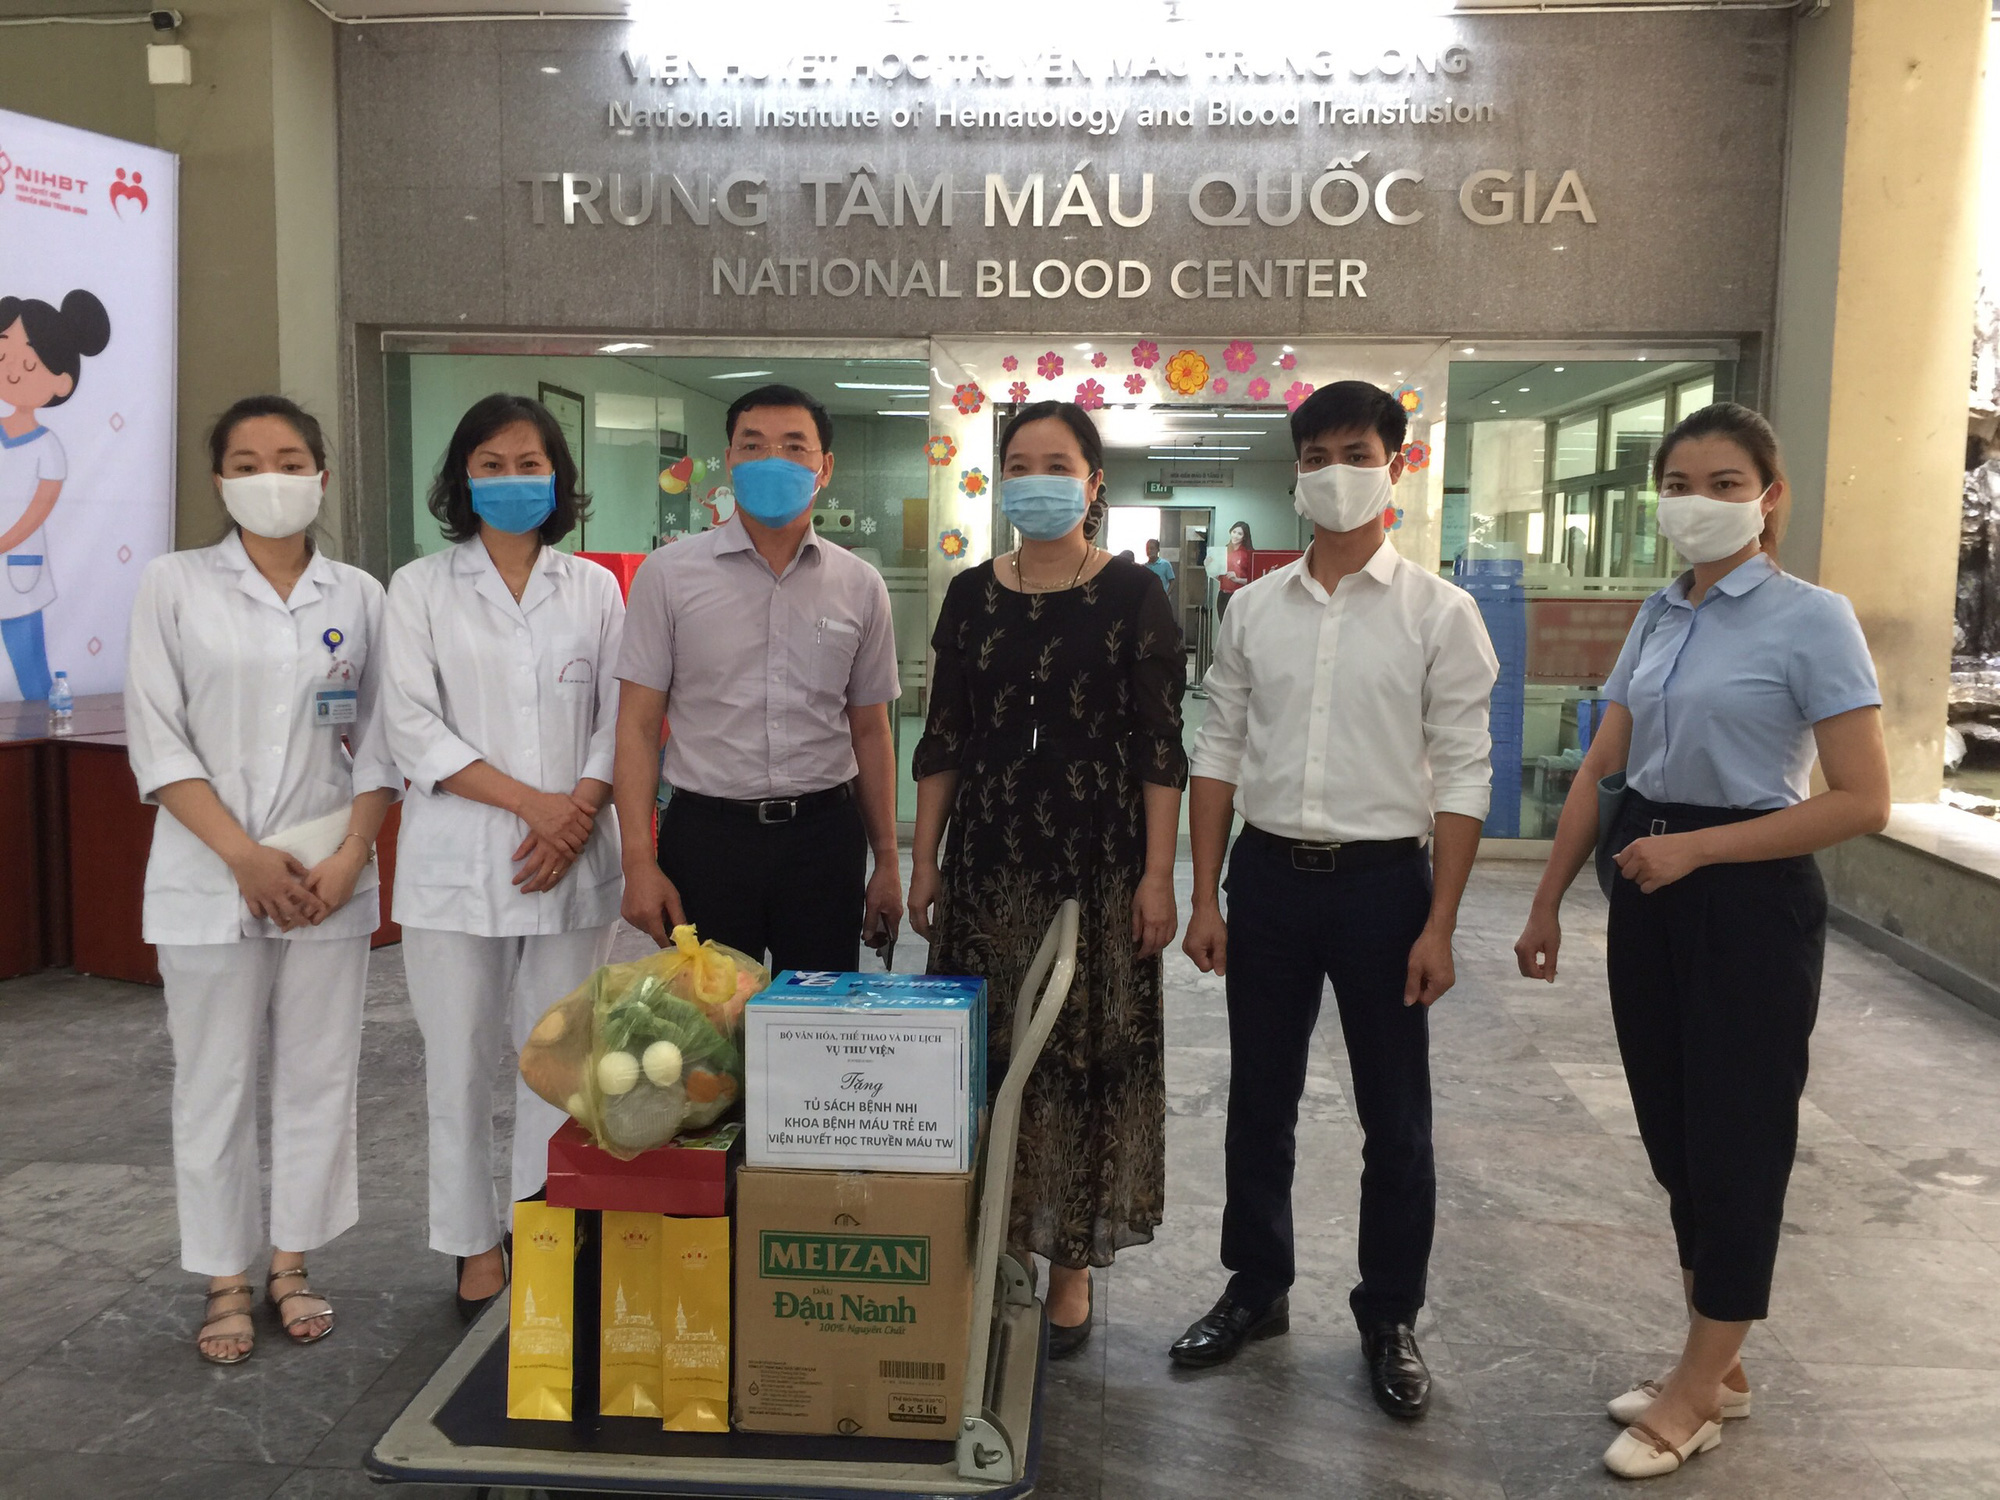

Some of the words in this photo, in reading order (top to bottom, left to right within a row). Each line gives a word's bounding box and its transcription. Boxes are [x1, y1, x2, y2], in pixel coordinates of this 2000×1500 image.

[608, 101, 741, 127] National
[754, 101, 879, 127] Institute
[891, 101, 922, 127] of
[935, 101, 1125, 135] Hematology
[1137, 101, 1194, 127] and
[1207, 101, 1299, 126] Blood
[1312, 97, 1494, 126] Transfusion
[15, 165, 88, 194] NIHBT
[516, 170, 768, 227] TRUNG
[800, 161, 953, 228] TÂM
[984, 160, 1153, 228] MÁU
[1188, 151, 1425, 227] QUỐC
[1459, 169, 1598, 225] GIA
[711, 257, 962, 298] NATIONAL
[975, 259, 1152, 299] BLOOD
[1170, 258, 1368, 299] CENTER
[780, 1030, 793, 1041] BỘ
[795, 1031, 813, 1040] VĂN
[816, 1031, 838, 1041] HÓA,
[861, 1033, 887, 1041] THAO
[889, 1032, 901, 1042] VÀ
[903, 1034, 917, 1043] DU
[919, 1034, 942, 1045] LỊCH
[826, 1045, 840, 1056] VỤ
[843, 1045, 867, 1054] THƯ
[869, 1044, 895, 1057] VIỆN
[841, 1072, 884, 1097] Tặng
[804, 1096, 820, 1111] TỦ
[824, 1098, 855, 1112] SÁCH
[859, 1099, 892, 1114] BỆNH
[896, 1103, 917, 1113] NHI
[784, 1117, 819, 1128] KHOA
[823, 1116, 855, 1131] BỆNH
[859, 1117, 889, 1131] MÁU
[893, 1117, 914, 1131] TRẺ
[918, 1121, 937, 1131] EM
[768, 1132, 793, 1145] VIỆN
[797, 1132, 832, 1145] HUYẾT
[834, 1136, 857, 1147] HỌC
[860, 1134, 902, 1147] TRUYỀN
[906, 1136, 932, 1148] MÁU
[935, 1138, 953, 1148] TW
[768, 1241, 923, 1275] MEIZAN
[772, 1291, 834, 1326] Đậu
[840, 1294, 917, 1324] Nành
[819, 1323, 845, 1333] 100%
[847, 1324, 882, 1336] Nguyên
[898, 1403, 905, 1412] 4
[907, 1405, 914, 1413] x
[917, 1404, 923, 1413] 5
